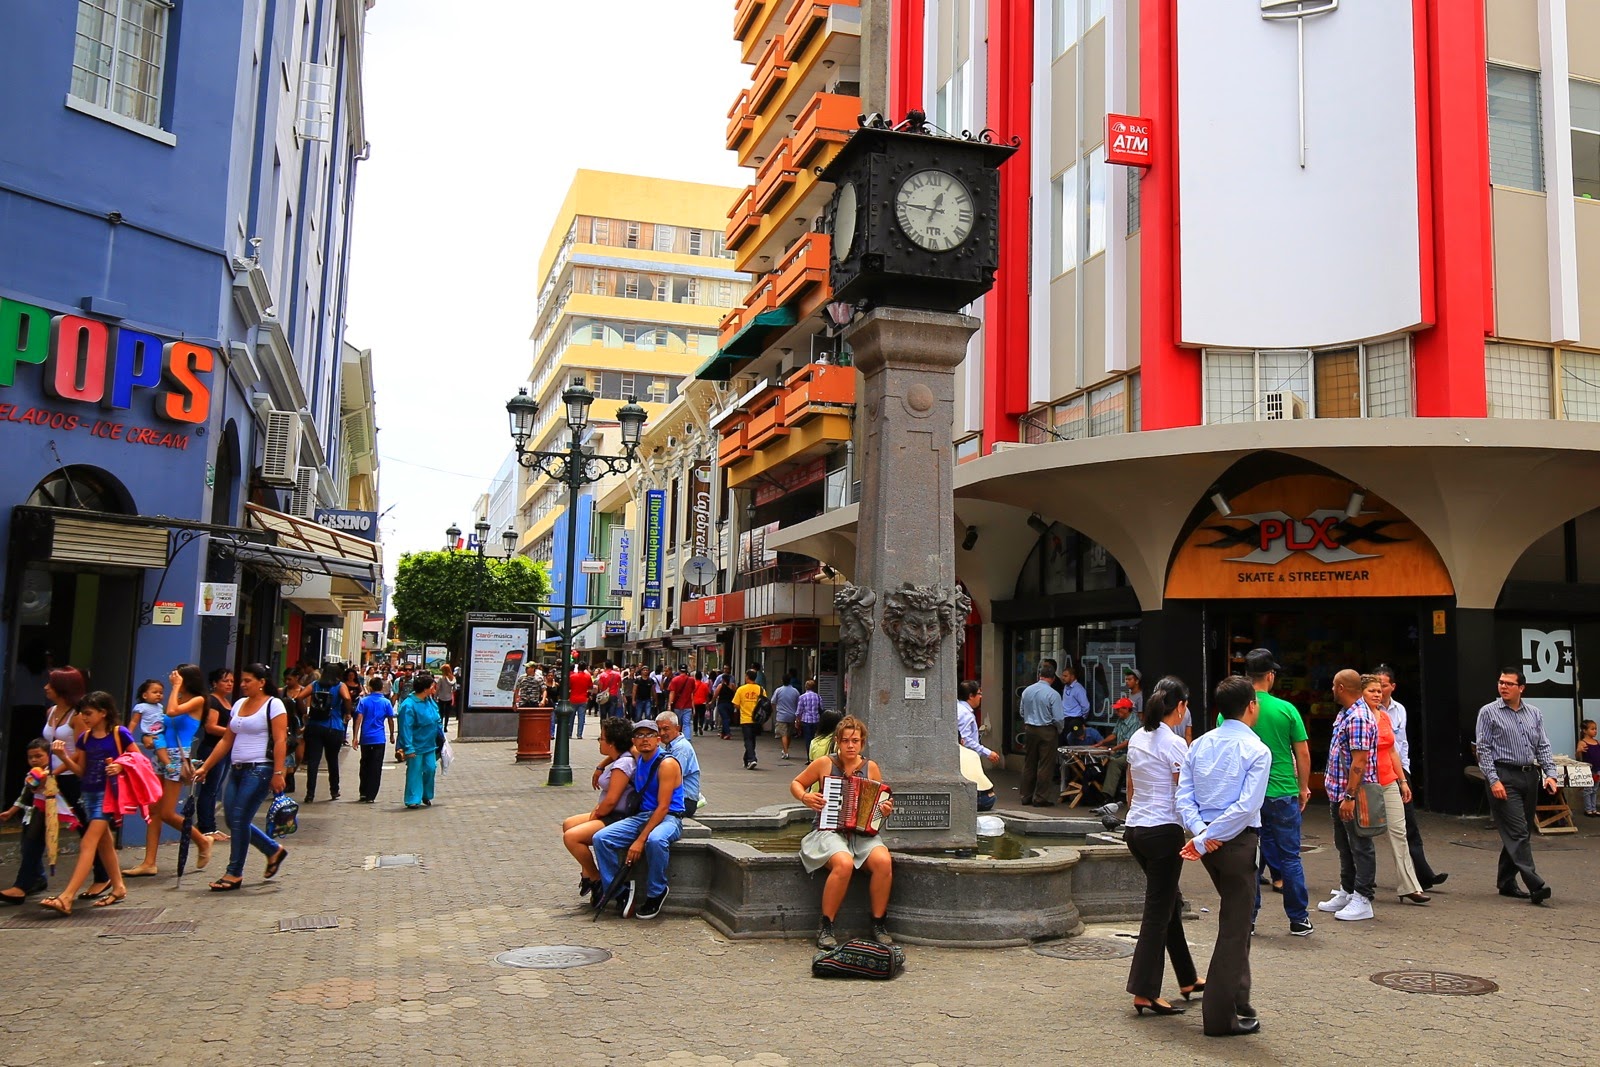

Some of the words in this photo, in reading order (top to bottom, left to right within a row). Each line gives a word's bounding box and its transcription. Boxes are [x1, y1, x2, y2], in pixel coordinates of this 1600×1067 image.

[1129, 125, 1148, 134] BAC
[1113, 134, 1148, 151] ATM
[926, 226, 941, 236] ITR
[0, 296, 214, 424] POPS
[90, 421, 124, 440] ICE
[126, 426, 190, 450] CREAM
[318, 514, 371, 531] CASINO
[1259, 517, 1340, 551] PLX
[1238, 572, 1274, 583] SKATE
[1278, 574, 1285, 582] &
[1288, 570, 1369, 582] STREETWEAR
[1521, 628, 1574, 685] DC
